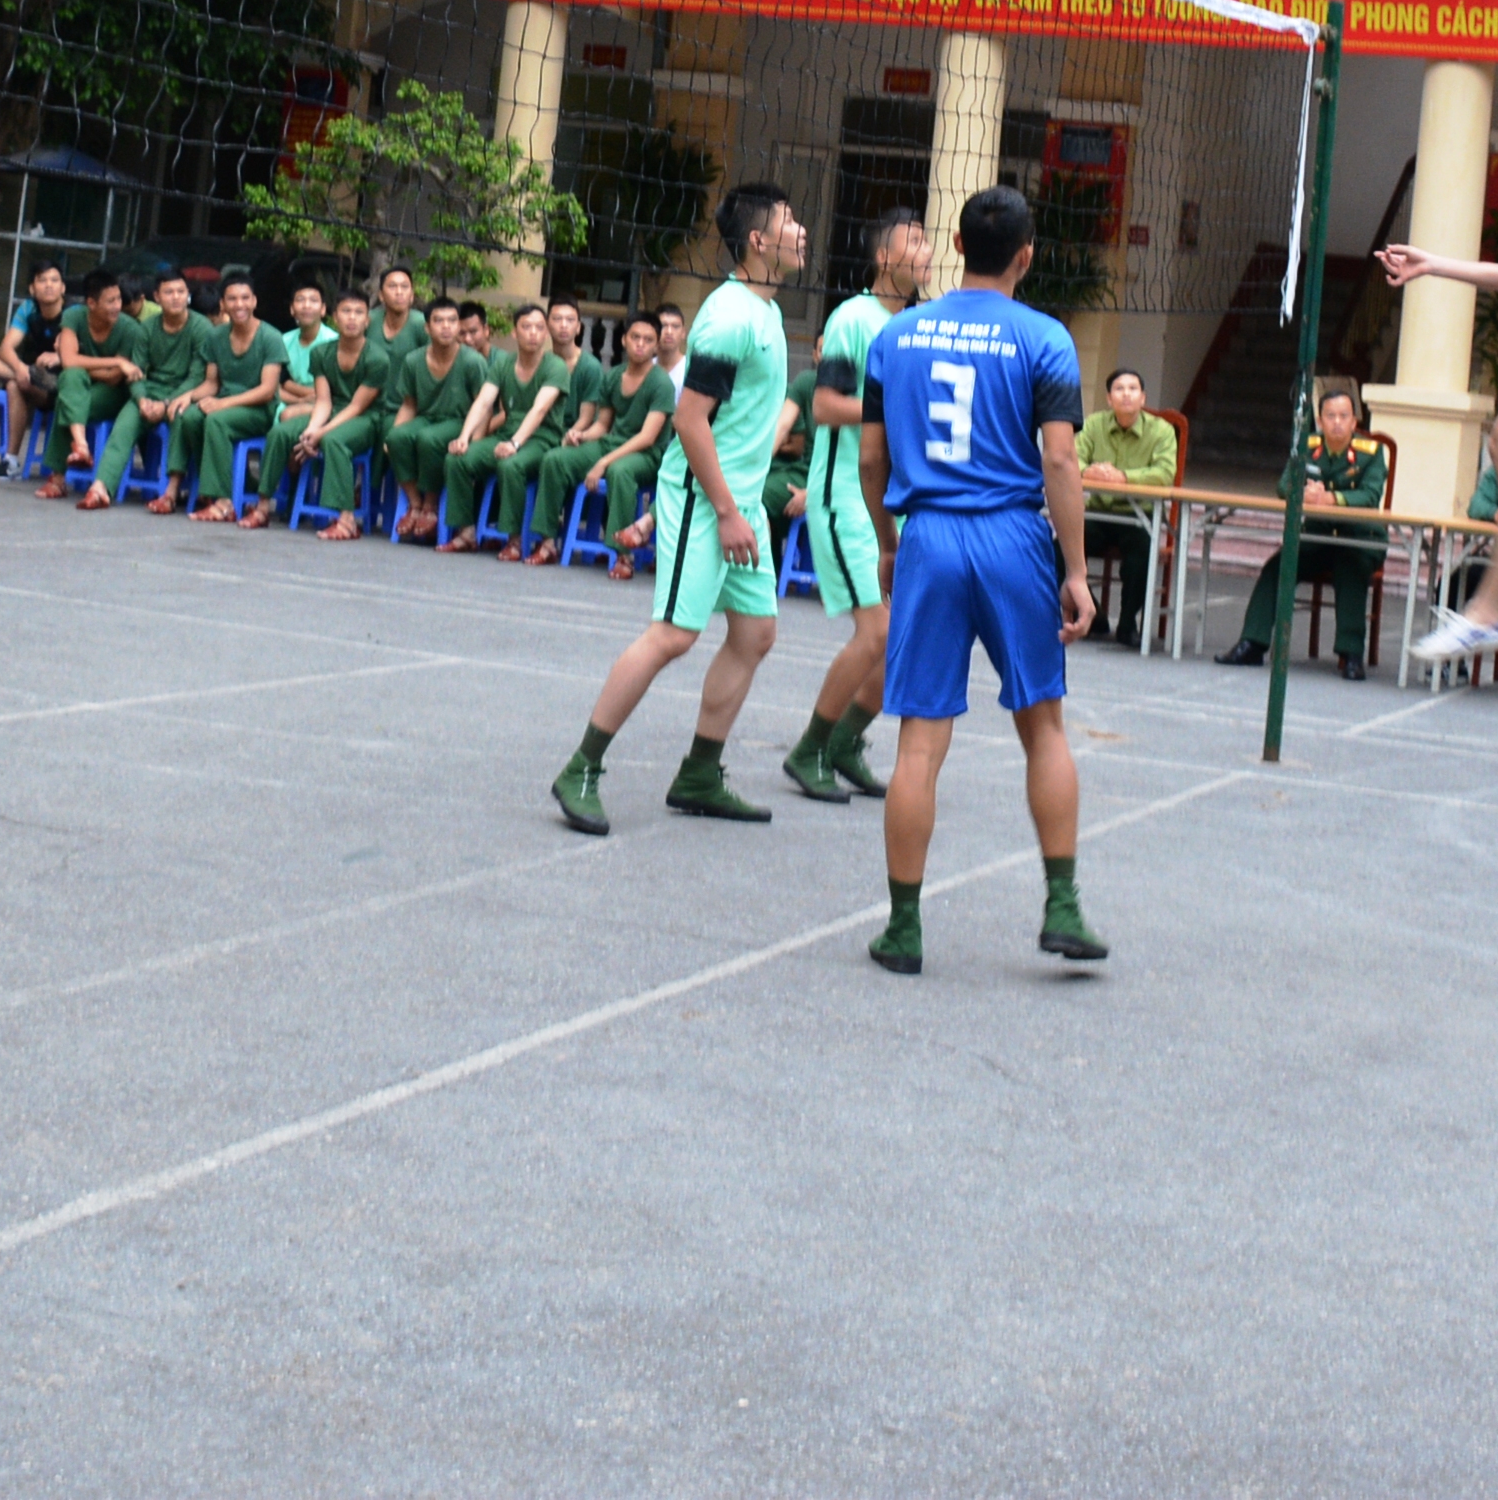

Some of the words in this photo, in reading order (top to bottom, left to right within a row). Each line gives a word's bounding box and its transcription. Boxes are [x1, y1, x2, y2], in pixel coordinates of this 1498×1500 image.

[1351, 0, 1430, 35] PHONG
[991, 324, 1001, 338] 2
[925, 360, 976, 464] 3
